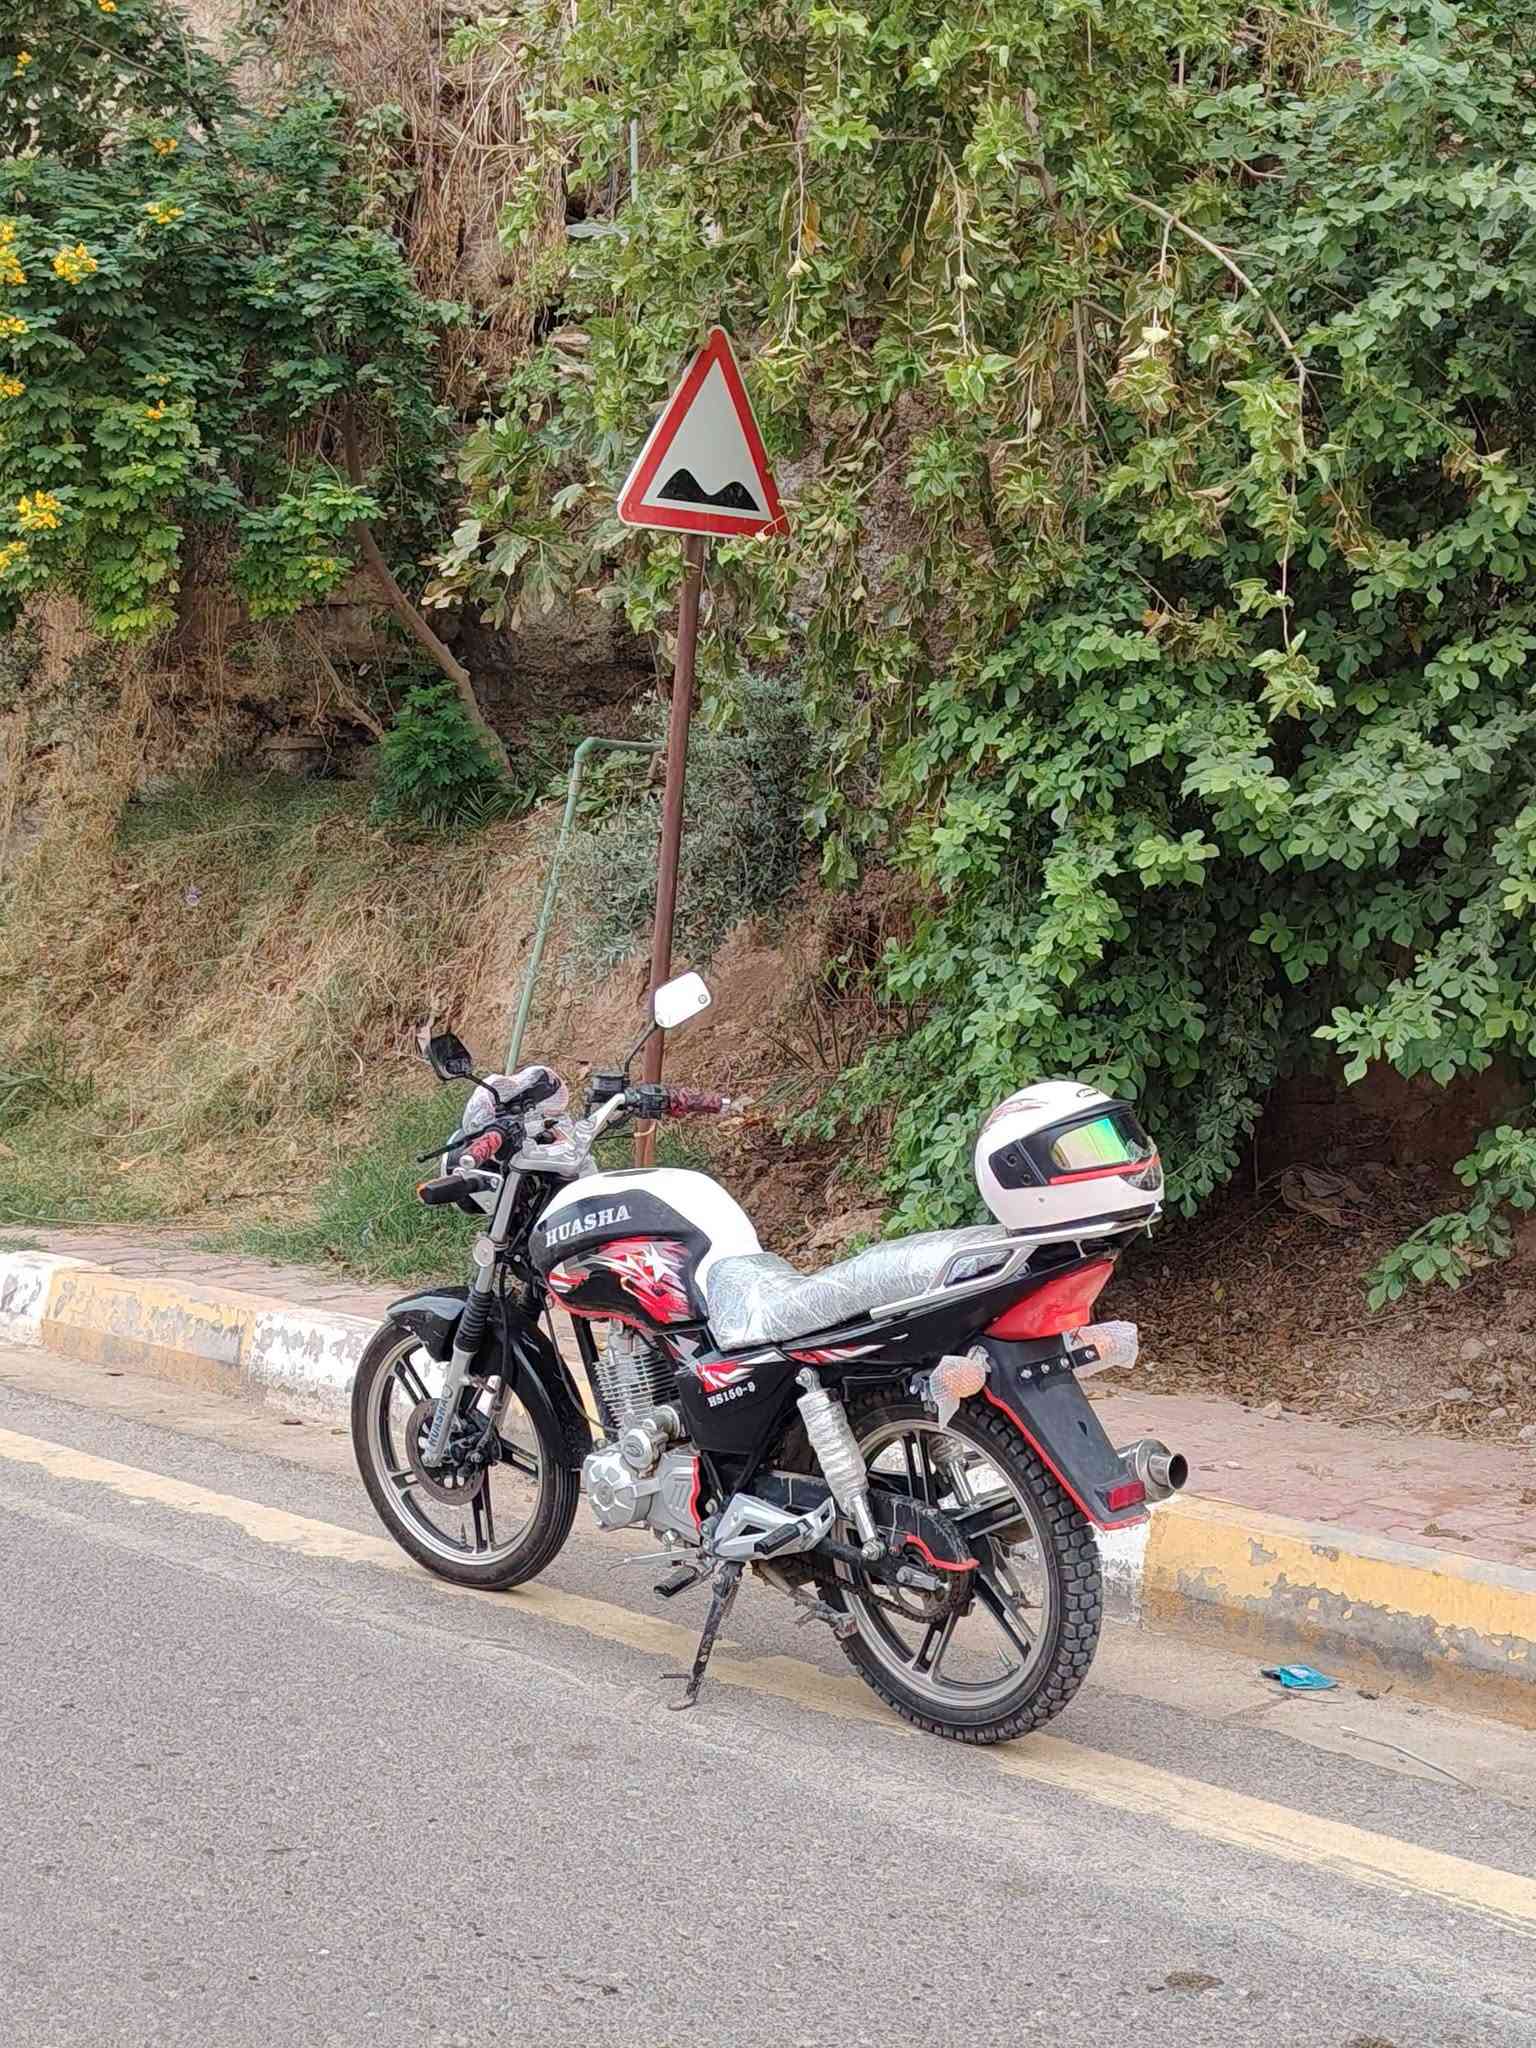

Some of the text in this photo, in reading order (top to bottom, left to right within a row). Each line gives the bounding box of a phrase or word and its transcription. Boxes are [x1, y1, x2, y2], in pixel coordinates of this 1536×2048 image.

[544, 1204, 632, 1247] HUASHA
[707, 1381, 756, 1407] HS150-9
[429, 1399, 448, 1447] HUASHA
